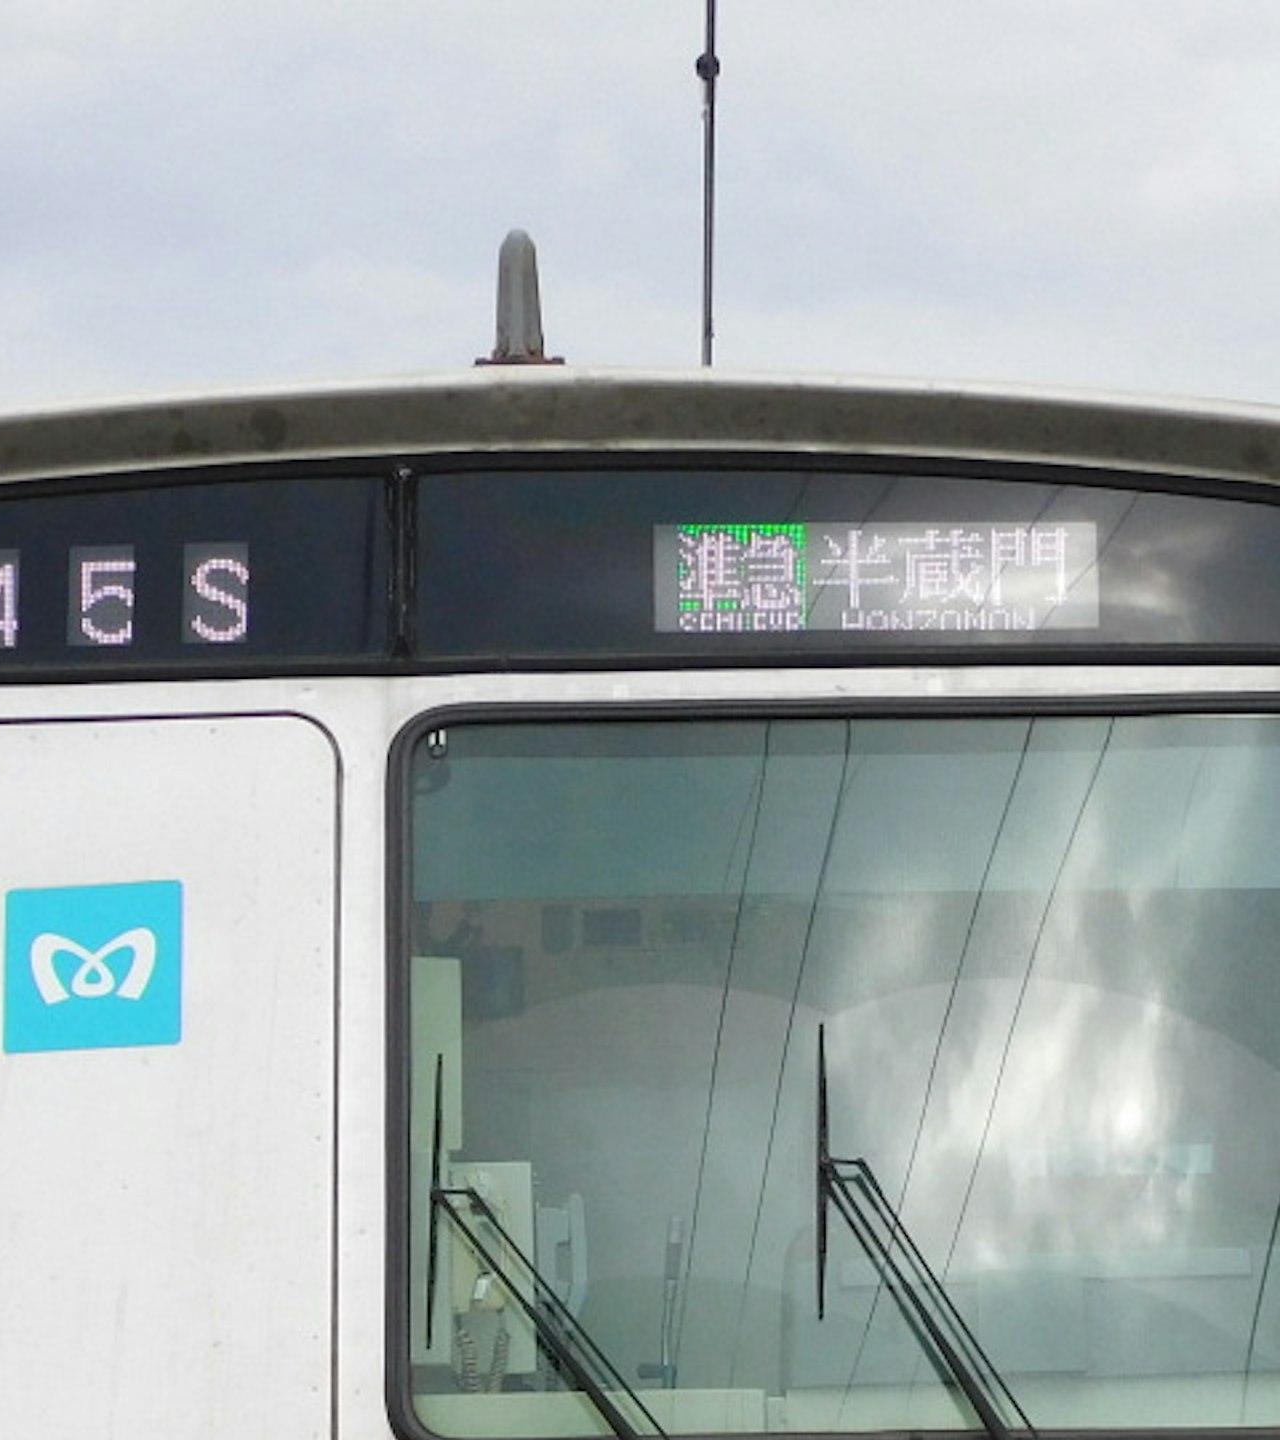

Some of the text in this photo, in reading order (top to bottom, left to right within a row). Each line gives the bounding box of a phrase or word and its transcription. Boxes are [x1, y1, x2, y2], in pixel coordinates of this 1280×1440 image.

[679, 528, 1070, 611] 準急 半蔵門
